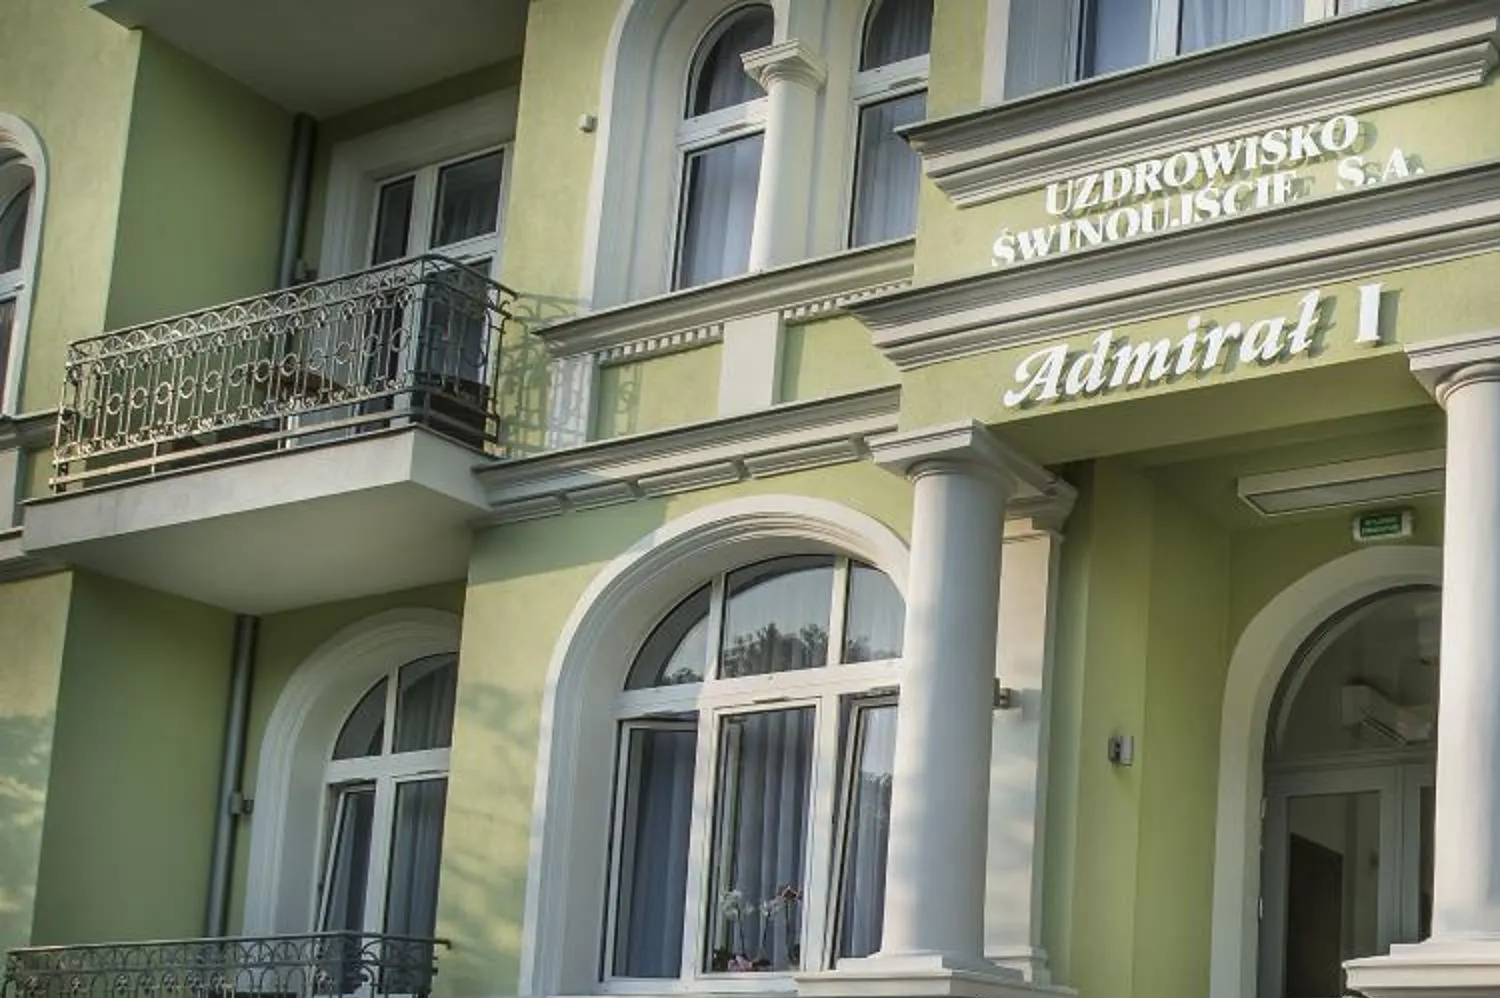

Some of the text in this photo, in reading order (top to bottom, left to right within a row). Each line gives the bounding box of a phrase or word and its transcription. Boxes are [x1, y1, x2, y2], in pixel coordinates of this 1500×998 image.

[1046, 114, 1360, 216] UZDROWISKO
[1335, 146, 1425, 191] S.A.
[1354, 281, 1384, 344] I
